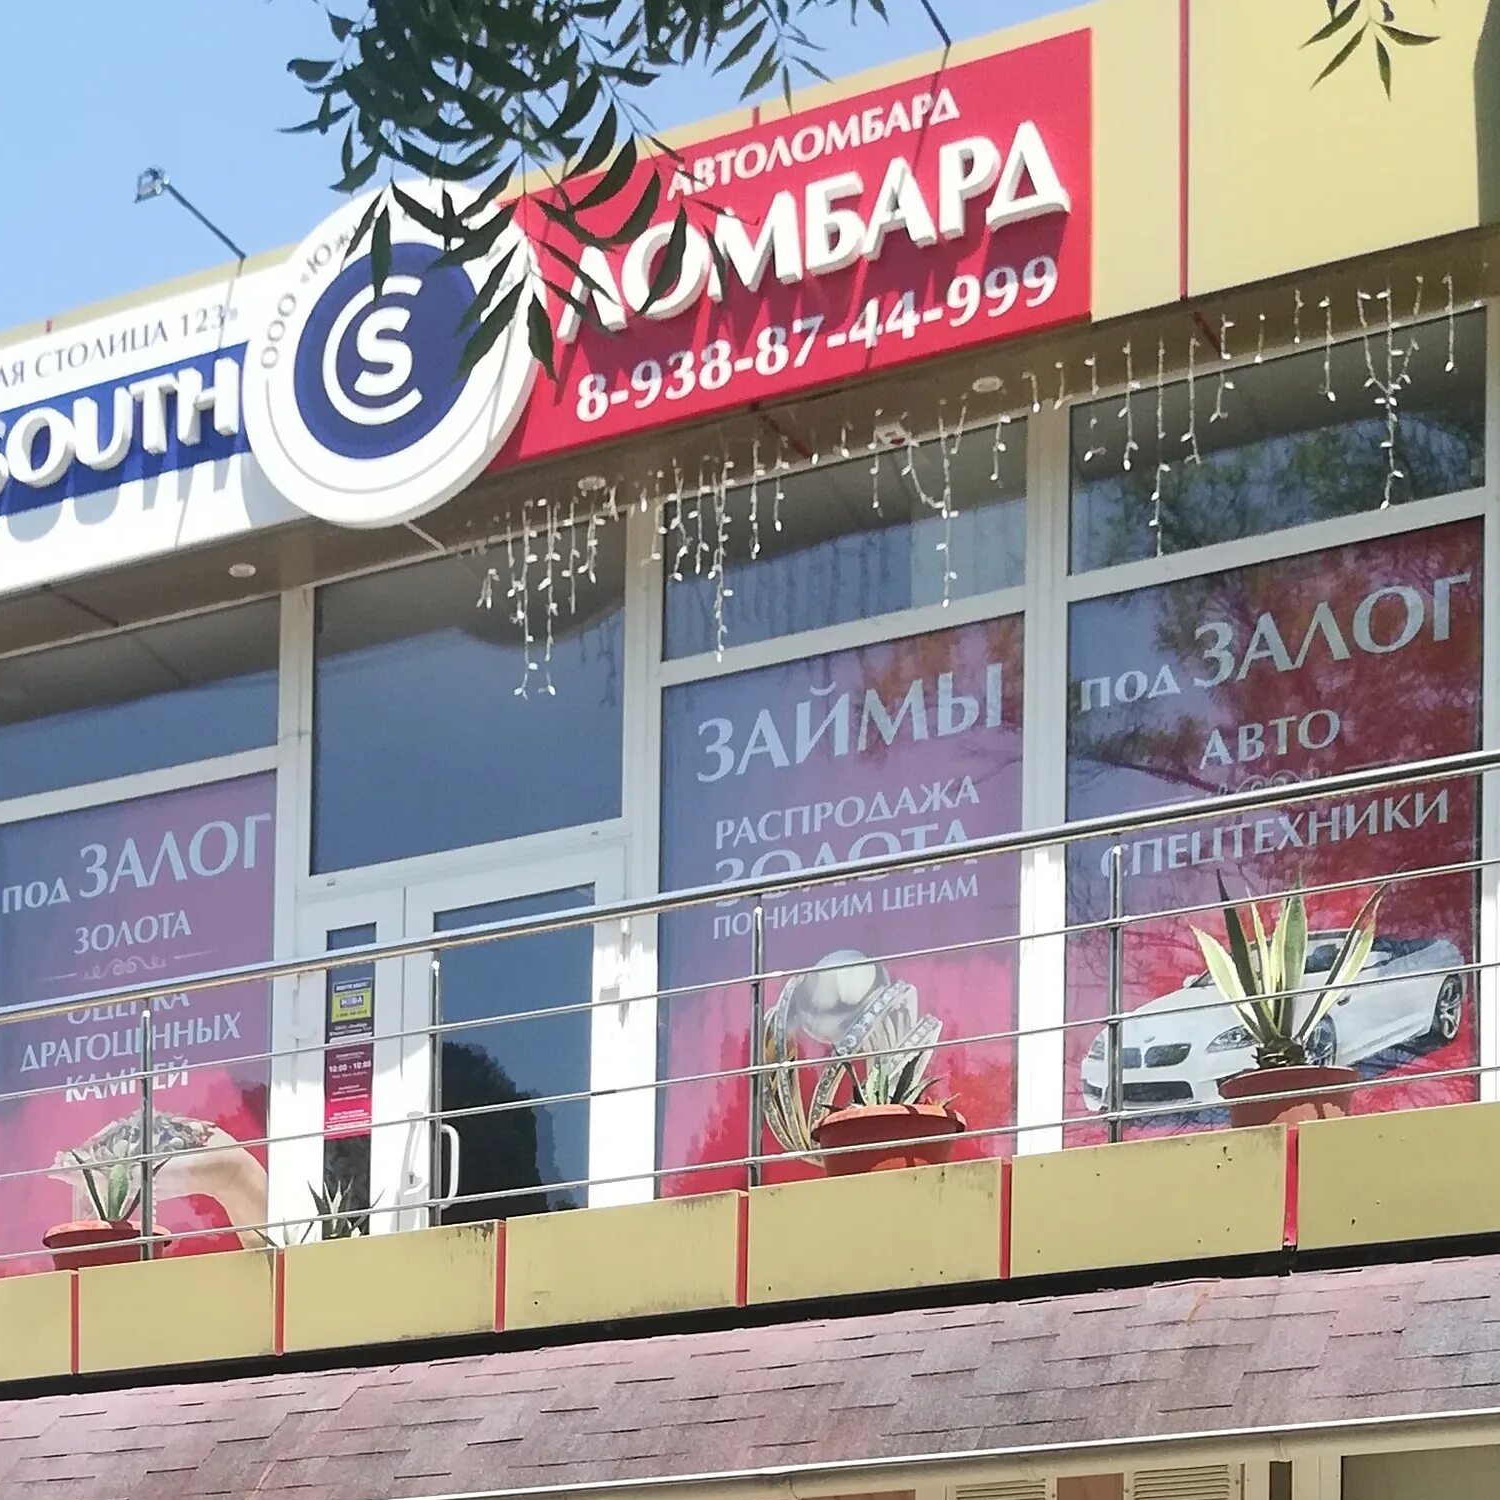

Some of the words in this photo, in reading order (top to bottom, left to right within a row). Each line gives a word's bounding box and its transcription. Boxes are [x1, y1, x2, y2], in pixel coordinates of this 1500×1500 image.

[666, 87, 961, 202] АВТОЛОМБАРД
[557, 120, 1071, 345] ЛОМБАРД
[33, 317, 169, 378] СТОЛИЦА
[261, 292, 297, 370] ООО
[576, 255, 1059, 423] 8-938-87-44-999
[1193, 571, 1473, 689] ЗАЛОГ
[696, 661, 1003, 784] ЗАЙМЫ
[1199, 709, 1342, 770] АВТО
[715, 775, 981, 851] РАСПРОДАЖА
[79, 812, 272, 899] ЗАЛОГ
[73, 909, 192, 955] ЗОЛОТА
[764, 890, 874, 932] НИЗКИМ
[882, 873, 980, 912] ЦЕНАМ
